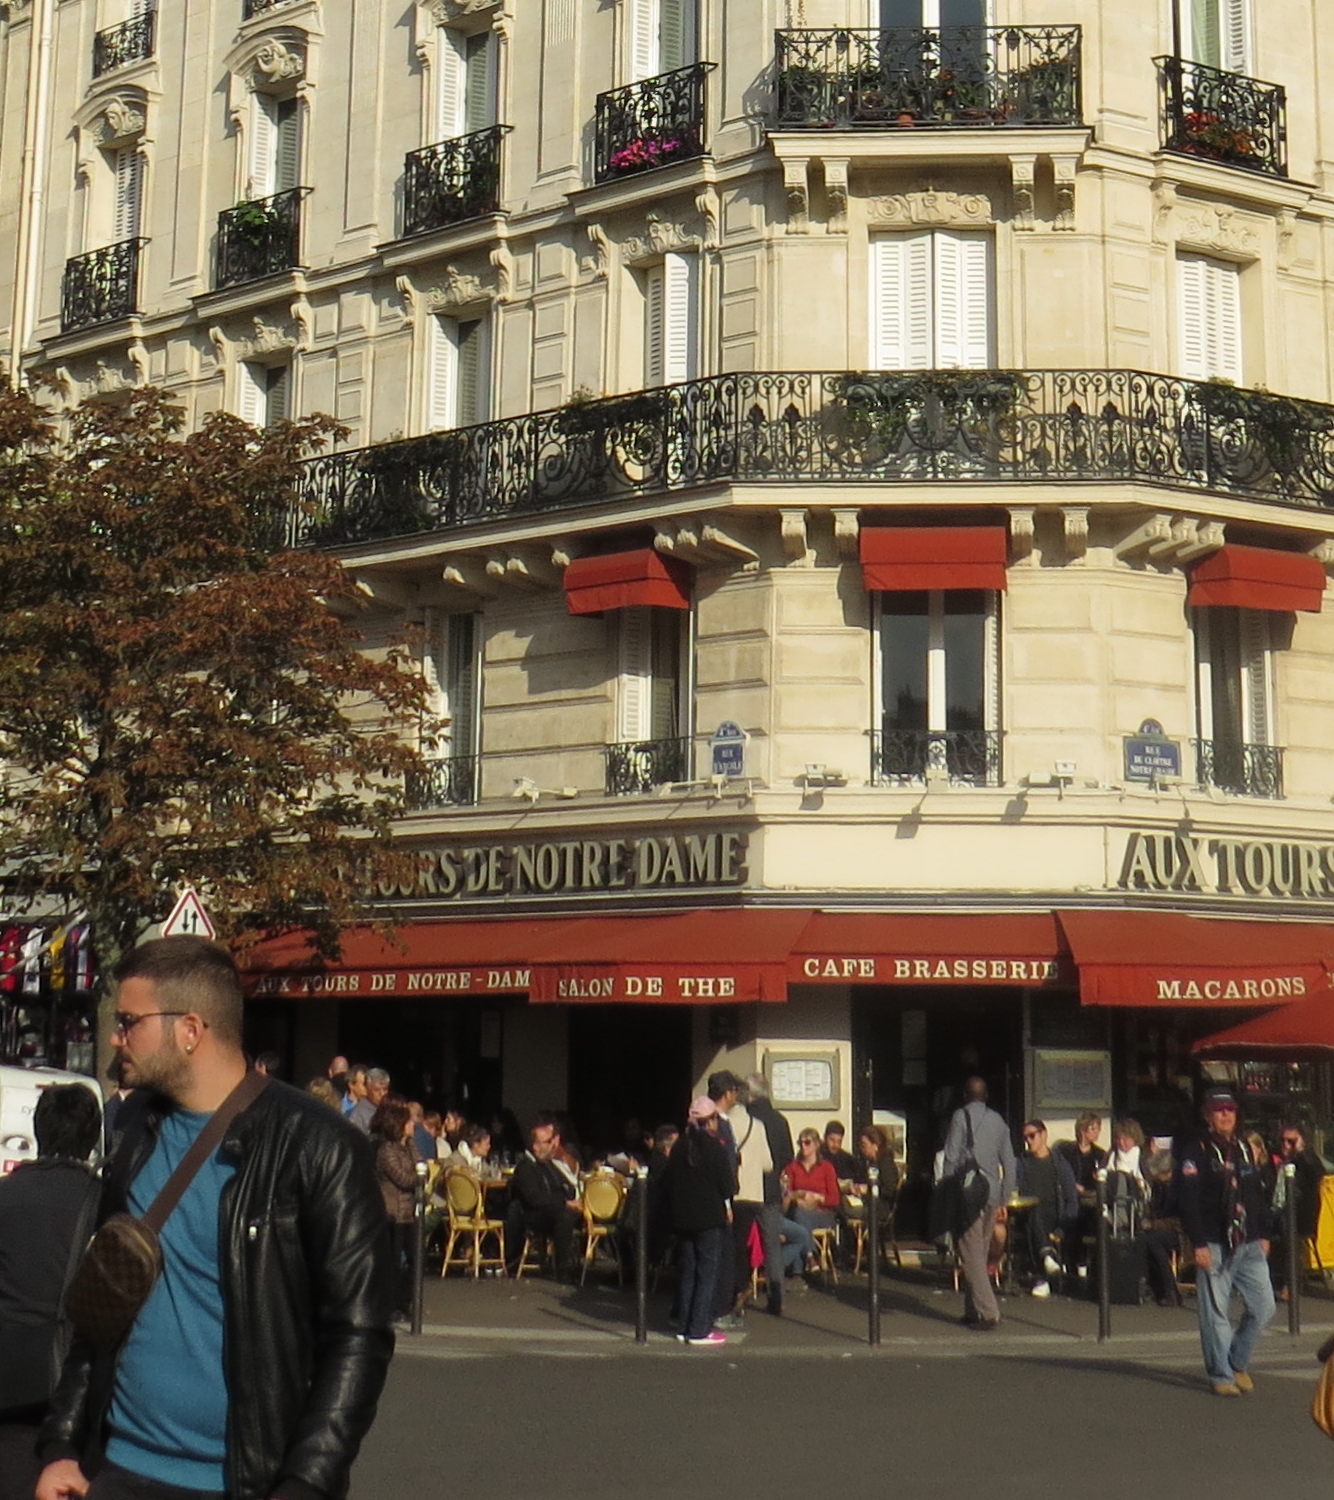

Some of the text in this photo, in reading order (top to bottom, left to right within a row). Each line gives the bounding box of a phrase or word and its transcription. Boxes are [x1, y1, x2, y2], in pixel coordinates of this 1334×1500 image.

[466, 846, 505, 893] DE
[514, 839, 626, 891] NOTRE
[637, 833, 741, 888] DAME
[1125, 834, 1208, 890] AUX
[803, 958, 1058, 981] CAFE BRASSERIE
[256, 974, 290, 993] AUX
[301, 974, 359, 993] TOURS
[370, 973, 396, 991] DE
[558, 976, 736, 997] SALON DE THE
[1156, 976, 1307, 1000] MACARONS
